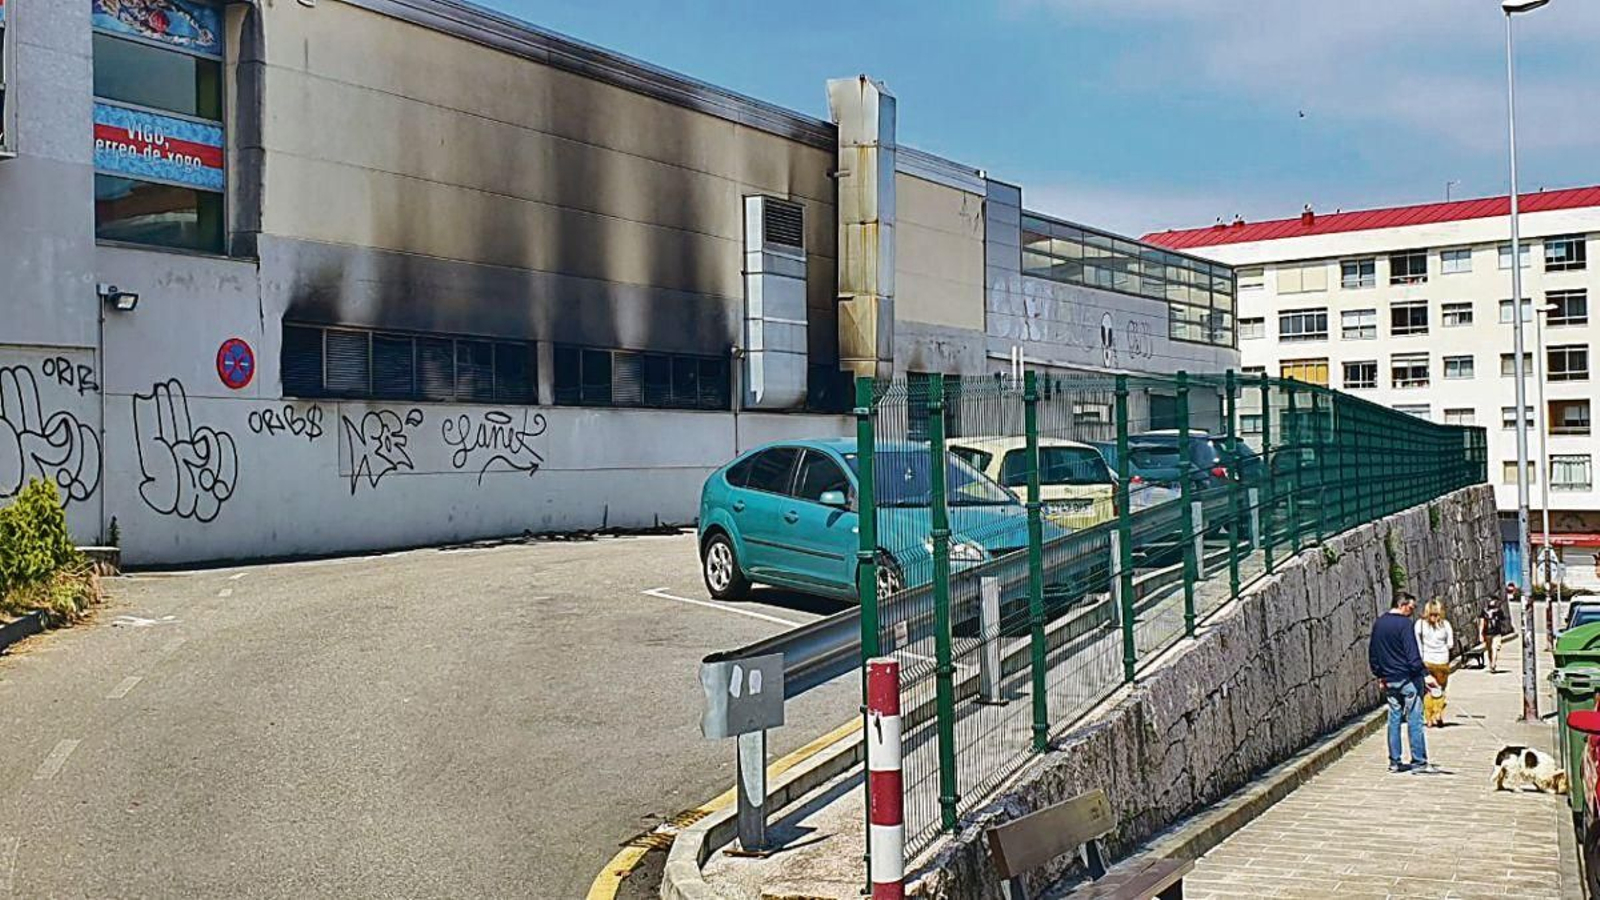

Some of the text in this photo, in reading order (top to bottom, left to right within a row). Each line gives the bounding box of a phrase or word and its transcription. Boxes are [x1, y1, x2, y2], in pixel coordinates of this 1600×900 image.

[127, 119, 170, 151] VIGO,
[94, 138, 203, 173] erreo de xogo
